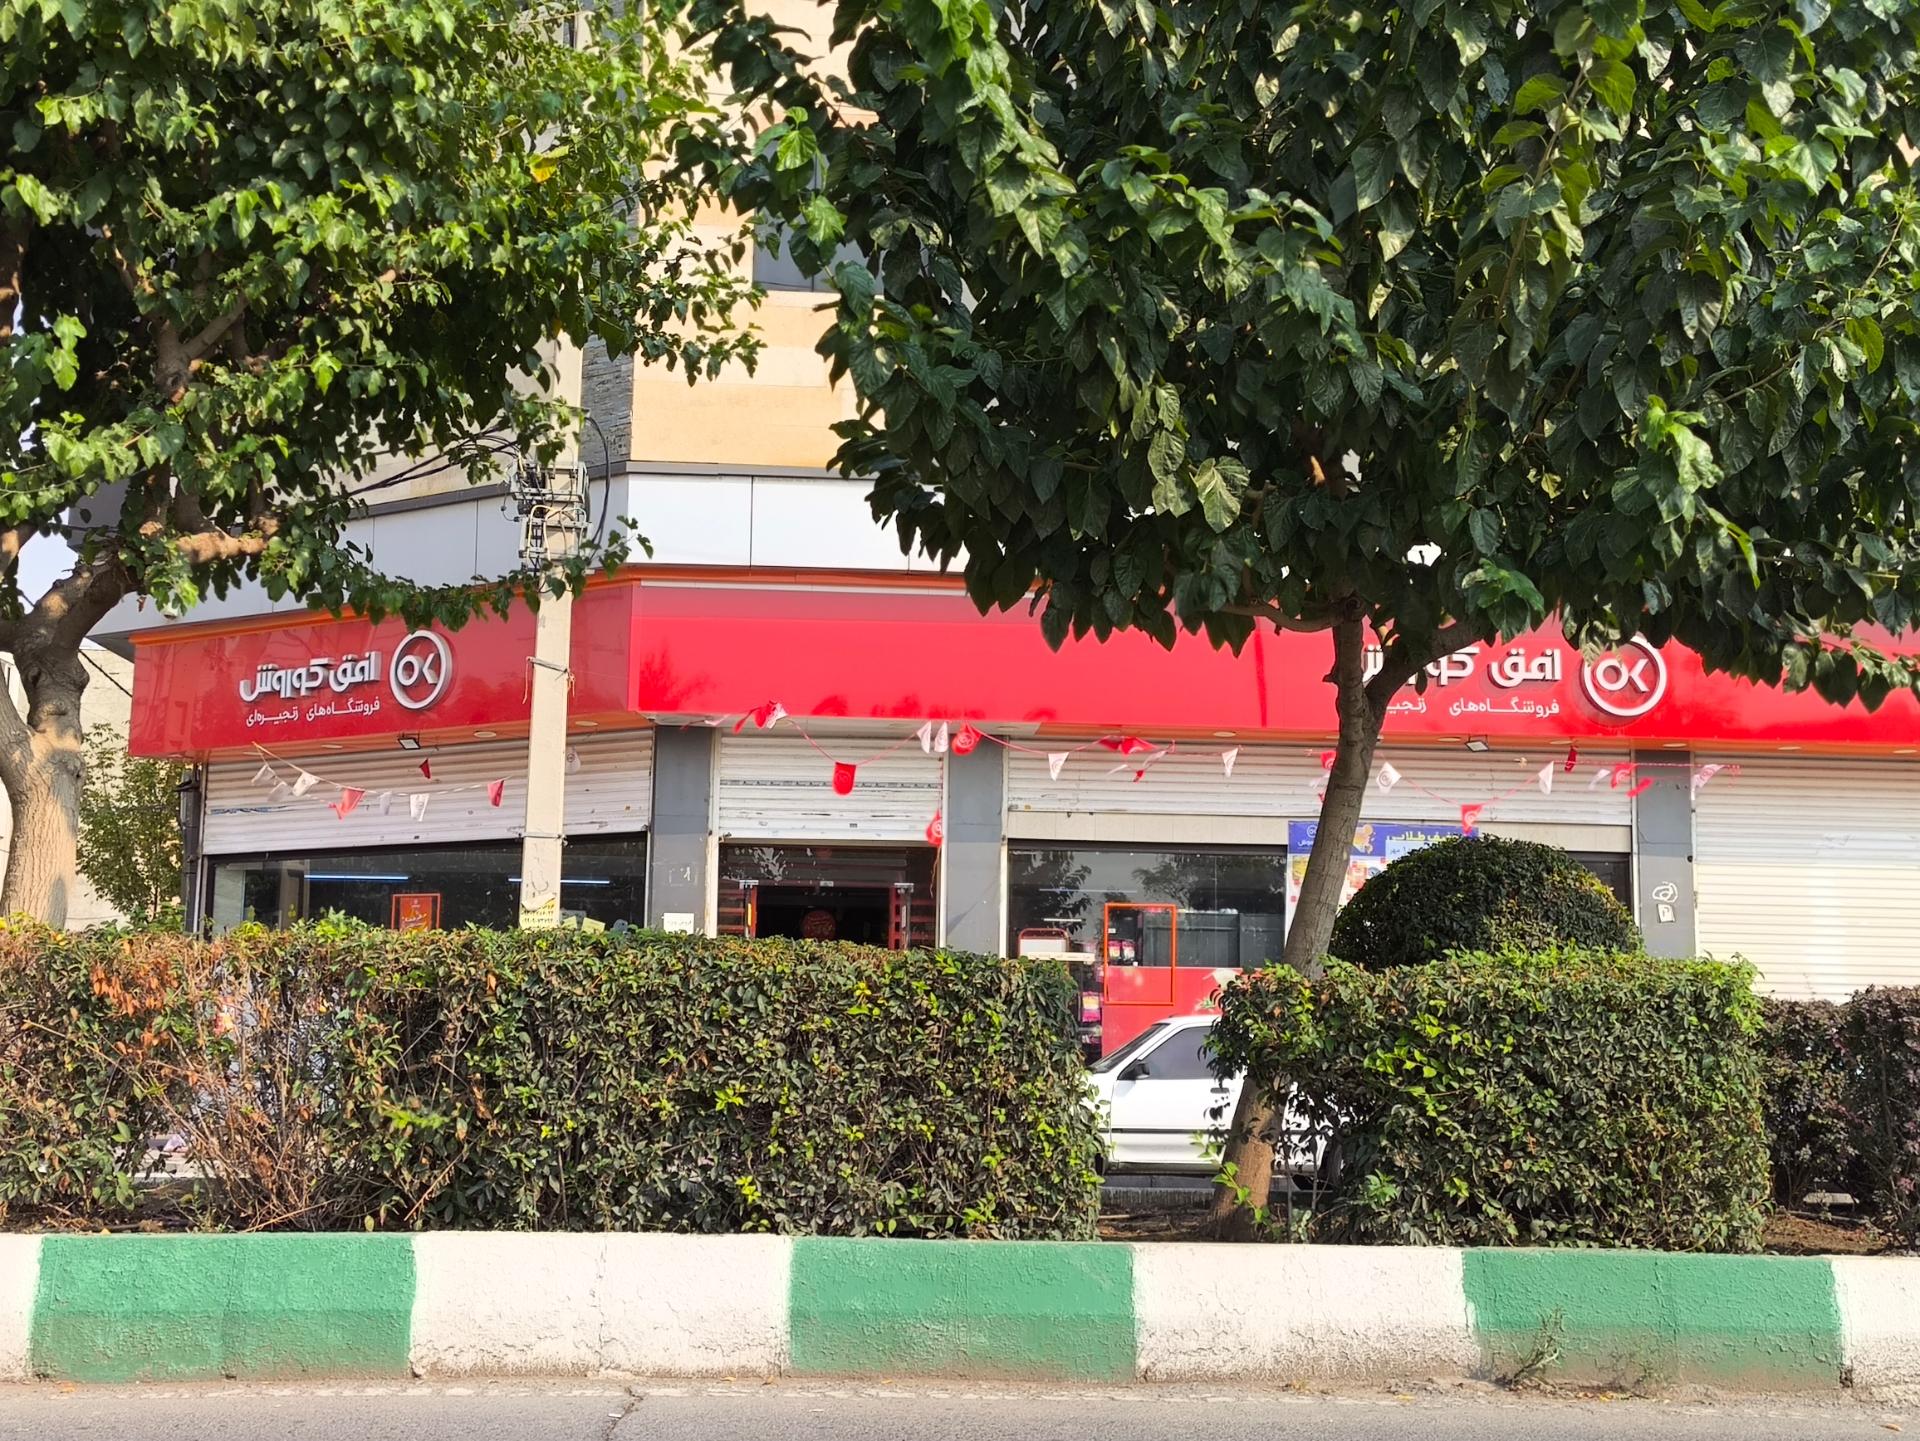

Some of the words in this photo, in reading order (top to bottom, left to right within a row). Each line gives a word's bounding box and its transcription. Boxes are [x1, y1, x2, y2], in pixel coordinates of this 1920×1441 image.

[239, 657, 329, 702] کوروش
[329, 651, 381, 693] افق
[1491, 647, 1561, 688] افق
